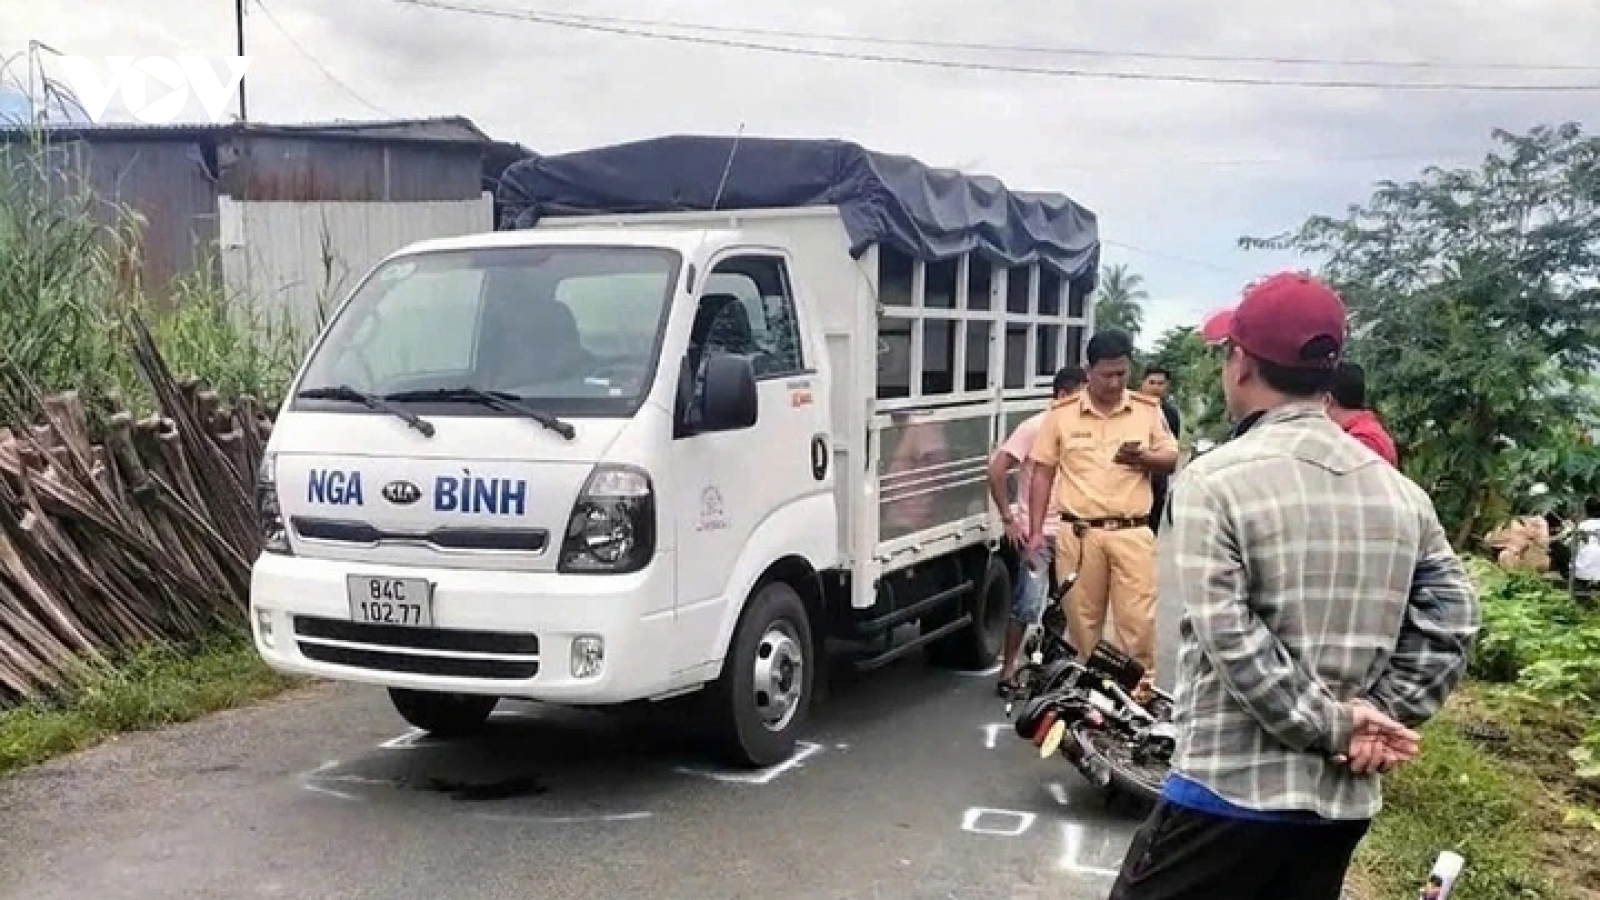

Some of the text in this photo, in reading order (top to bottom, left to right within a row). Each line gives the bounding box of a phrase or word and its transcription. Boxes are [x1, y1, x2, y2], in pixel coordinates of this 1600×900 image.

[308, 468, 527, 515] NGA BÌNH
[383, 482, 420, 503] KIA
[369, 579, 406, 601] 84C
[361, 602, 421, 625] 102.77
